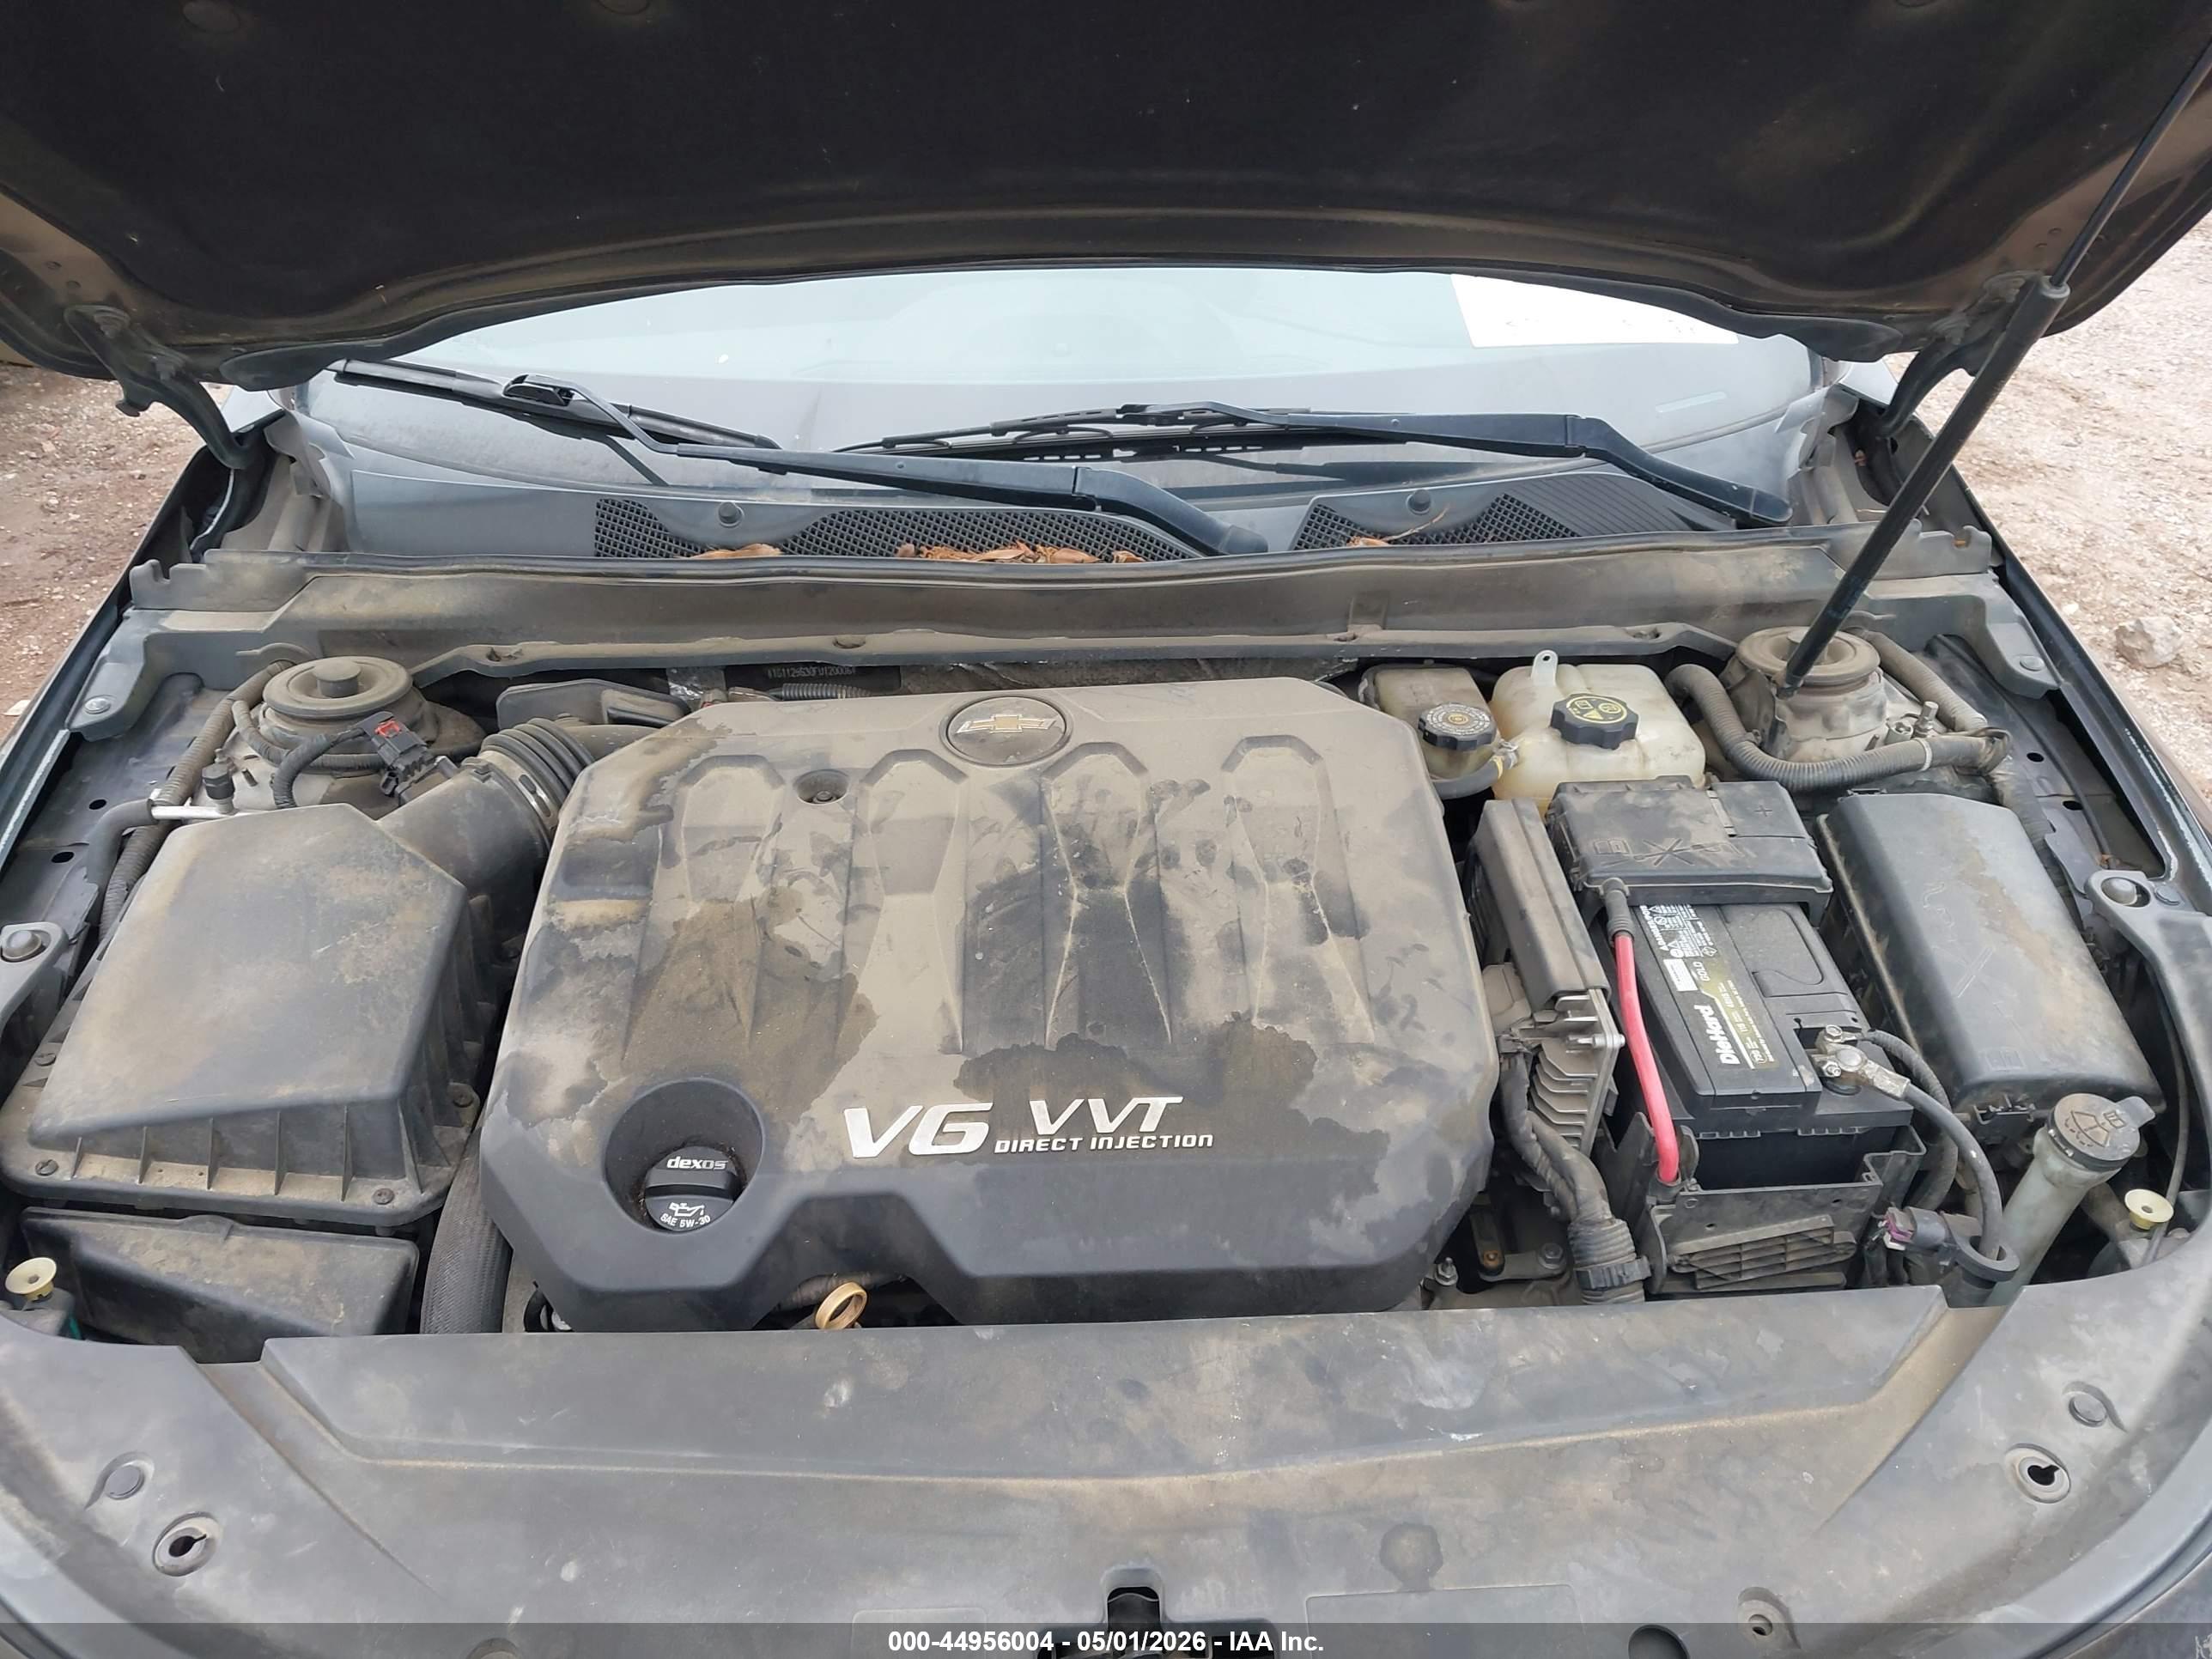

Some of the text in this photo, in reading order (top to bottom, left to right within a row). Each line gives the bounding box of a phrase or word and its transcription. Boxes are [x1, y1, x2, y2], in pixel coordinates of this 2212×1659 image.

[1692, 961, 1711, 981] GOLD
[1693, 1005, 1741, 1065] DieHard
[844, 1096, 1183, 1158] V6 VVT
[994, 1134, 1213, 1154] DIRECT INJECTION
[666, 1156, 729, 1171] dexos
[660, 1212, 711, 1228] SAE 5W-30
